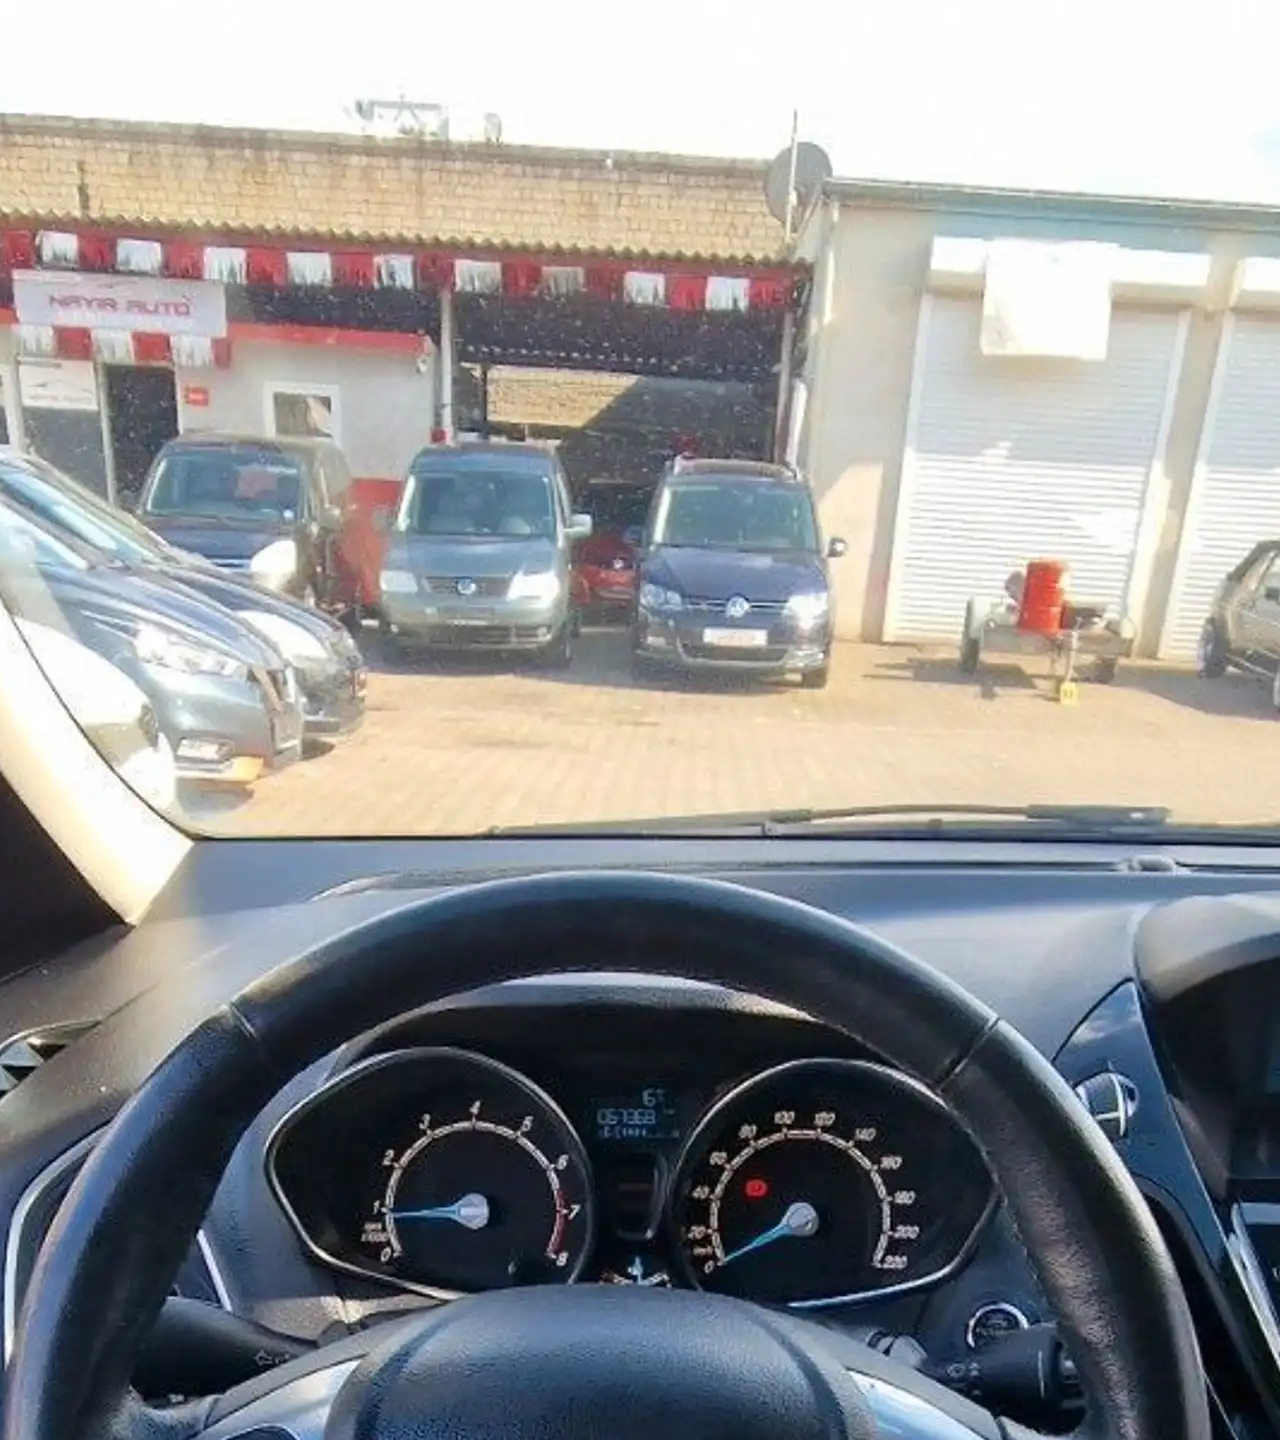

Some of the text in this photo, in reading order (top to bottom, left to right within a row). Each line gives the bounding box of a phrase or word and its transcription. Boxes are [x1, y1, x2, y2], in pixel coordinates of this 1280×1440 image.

[126, 299, 190, 316] AUTO
[470, 1100, 481, 1115] 4
[419, 1114, 430, 1129] 3
[522, 1116, 534, 1132] 5
[774, 1111, 795, 1125] 100
[815, 1111, 836, 1126] 120
[738, 1124, 758, 1139] 80
[854, 1128, 877, 1142] 140
[382, 1150, 394, 1165] 2
[556, 1154, 569, 1170] 6
[693, 1186, 710, 1199] 40
[373, 1201, 381, 1214] 1
[568, 1204, 580, 1220] 7
[688, 1225, 706, 1239] 20
[895, 1225, 920, 1239] 200
[381, 1247, 392, 1262] 0
[556, 1252, 568, 1266] 8
[704, 1262, 714, 1274] 0
[883, 1256, 908, 1269] 220
